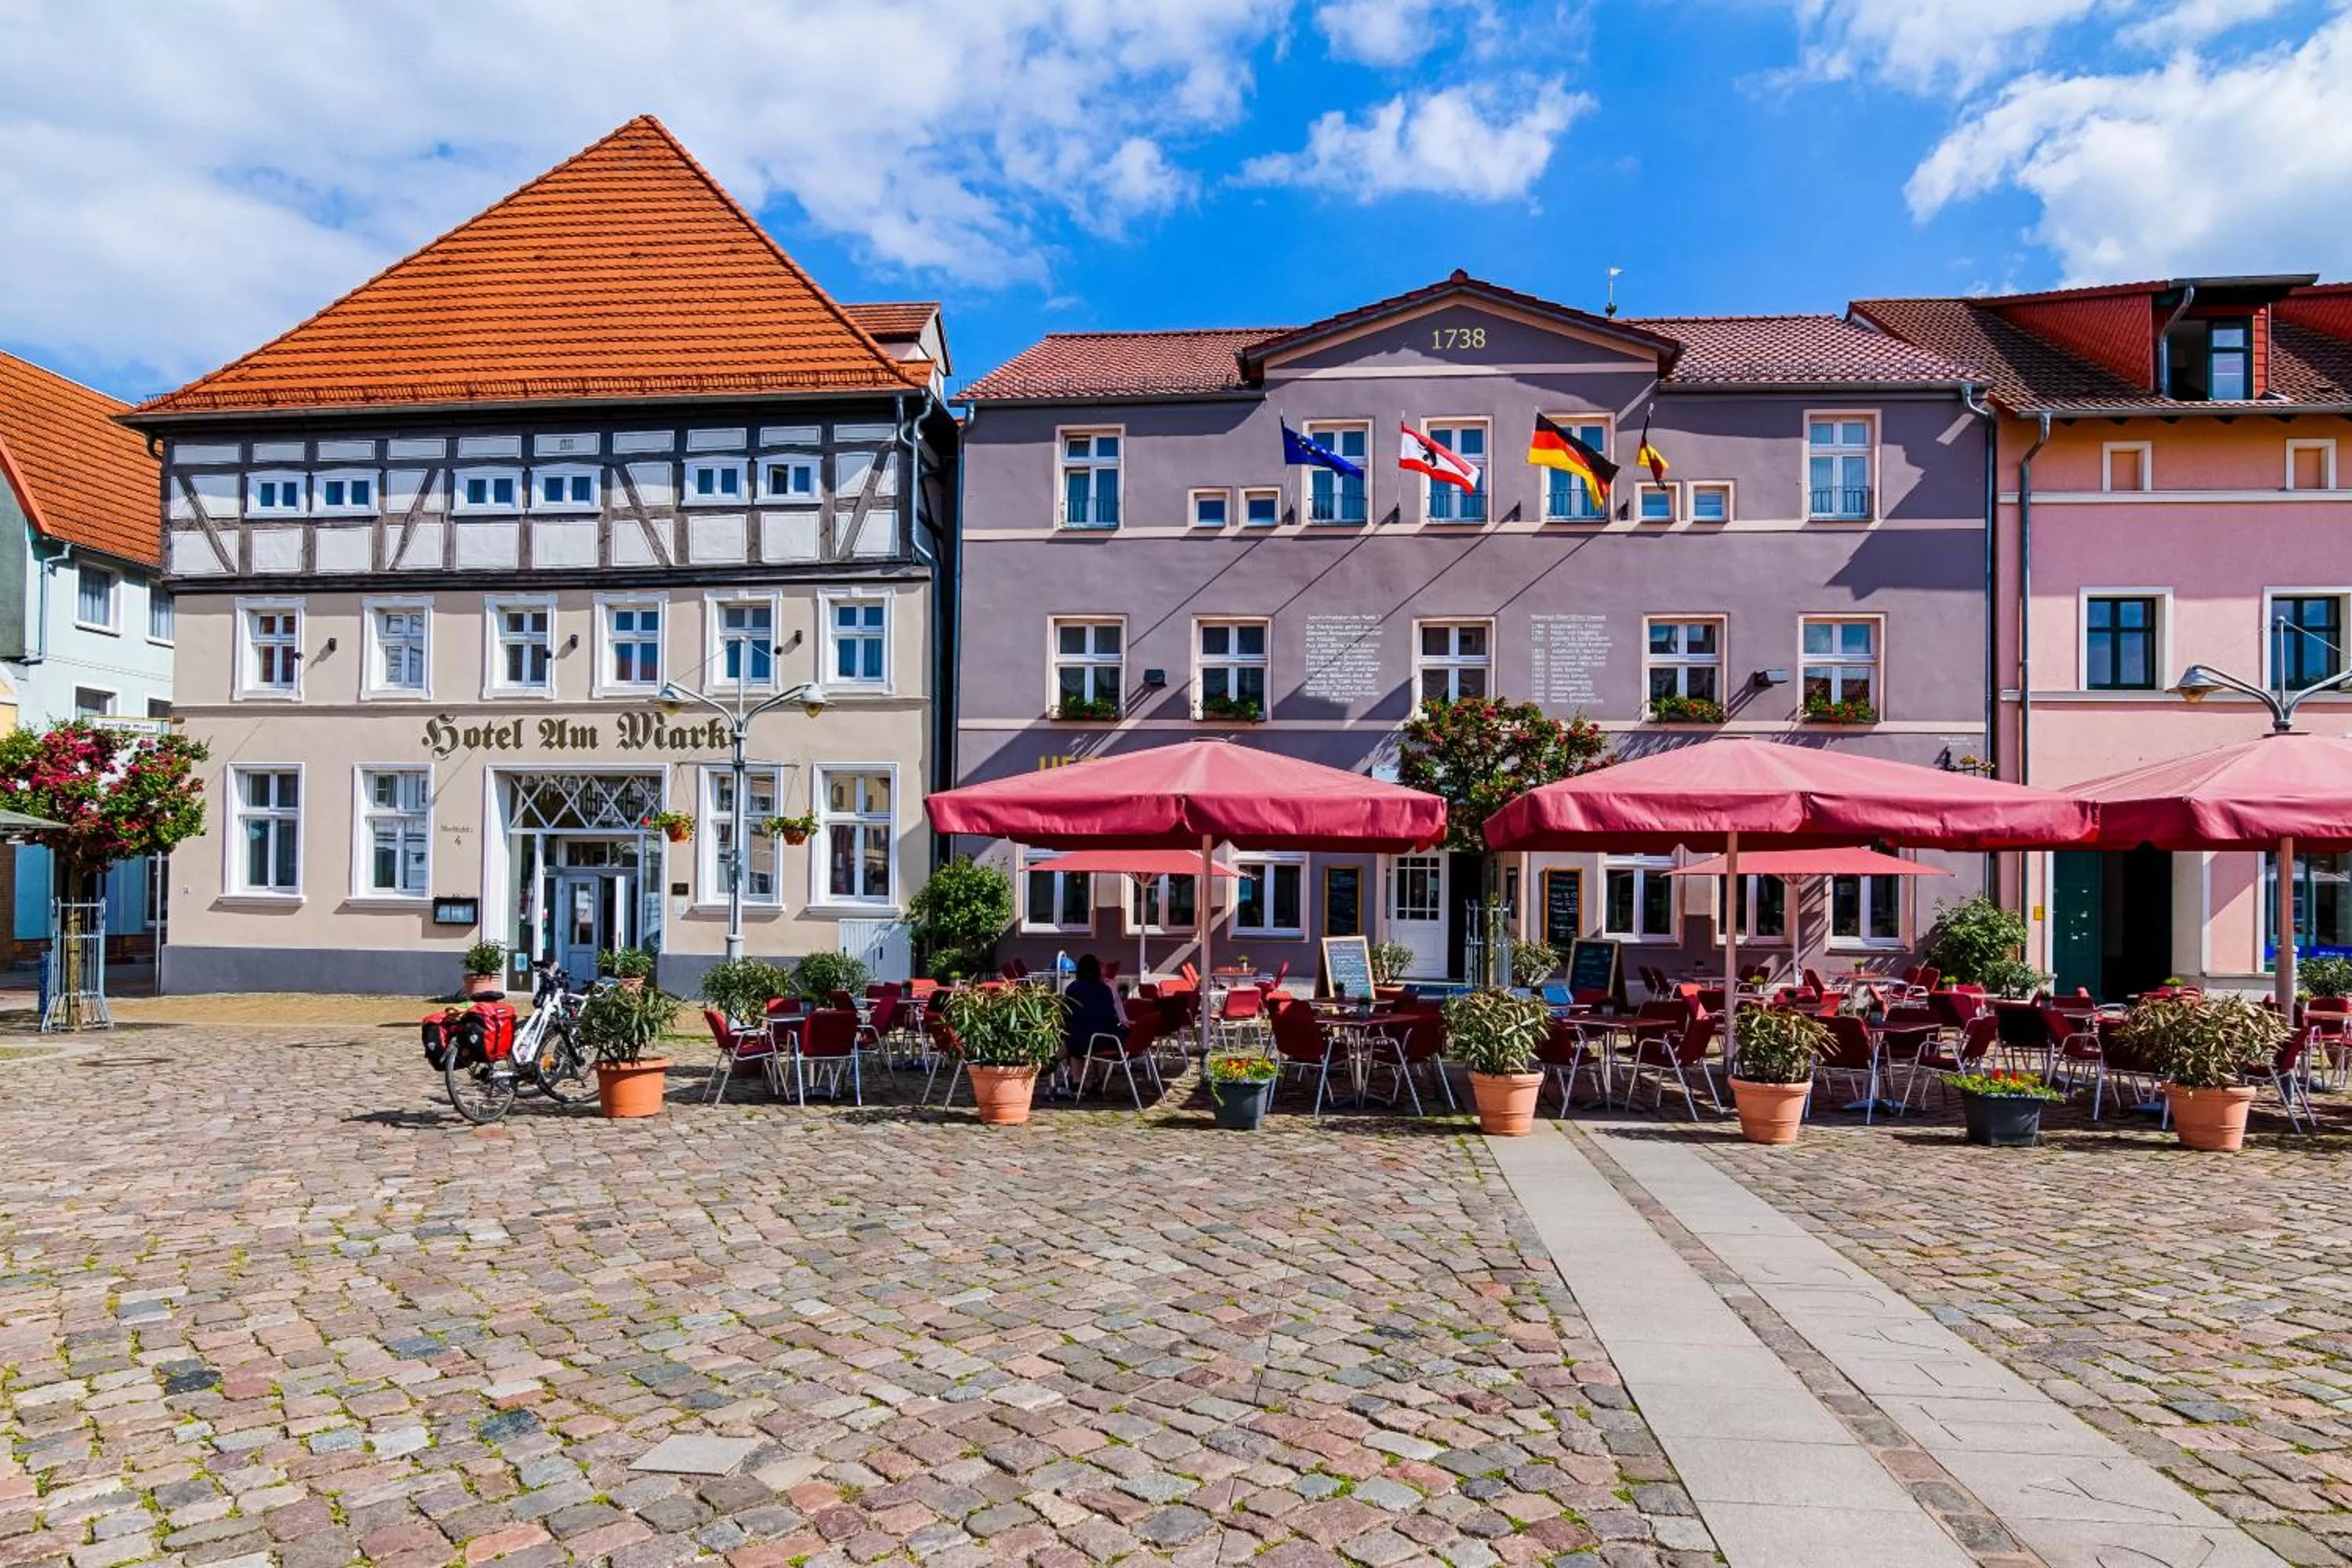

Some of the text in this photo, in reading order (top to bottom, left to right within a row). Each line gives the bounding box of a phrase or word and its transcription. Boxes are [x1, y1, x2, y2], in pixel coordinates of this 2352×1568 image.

[1432, 328, 1486, 350] 1738
[421, 713, 524, 760] Hotel
[539, 718, 599, 750] Am
